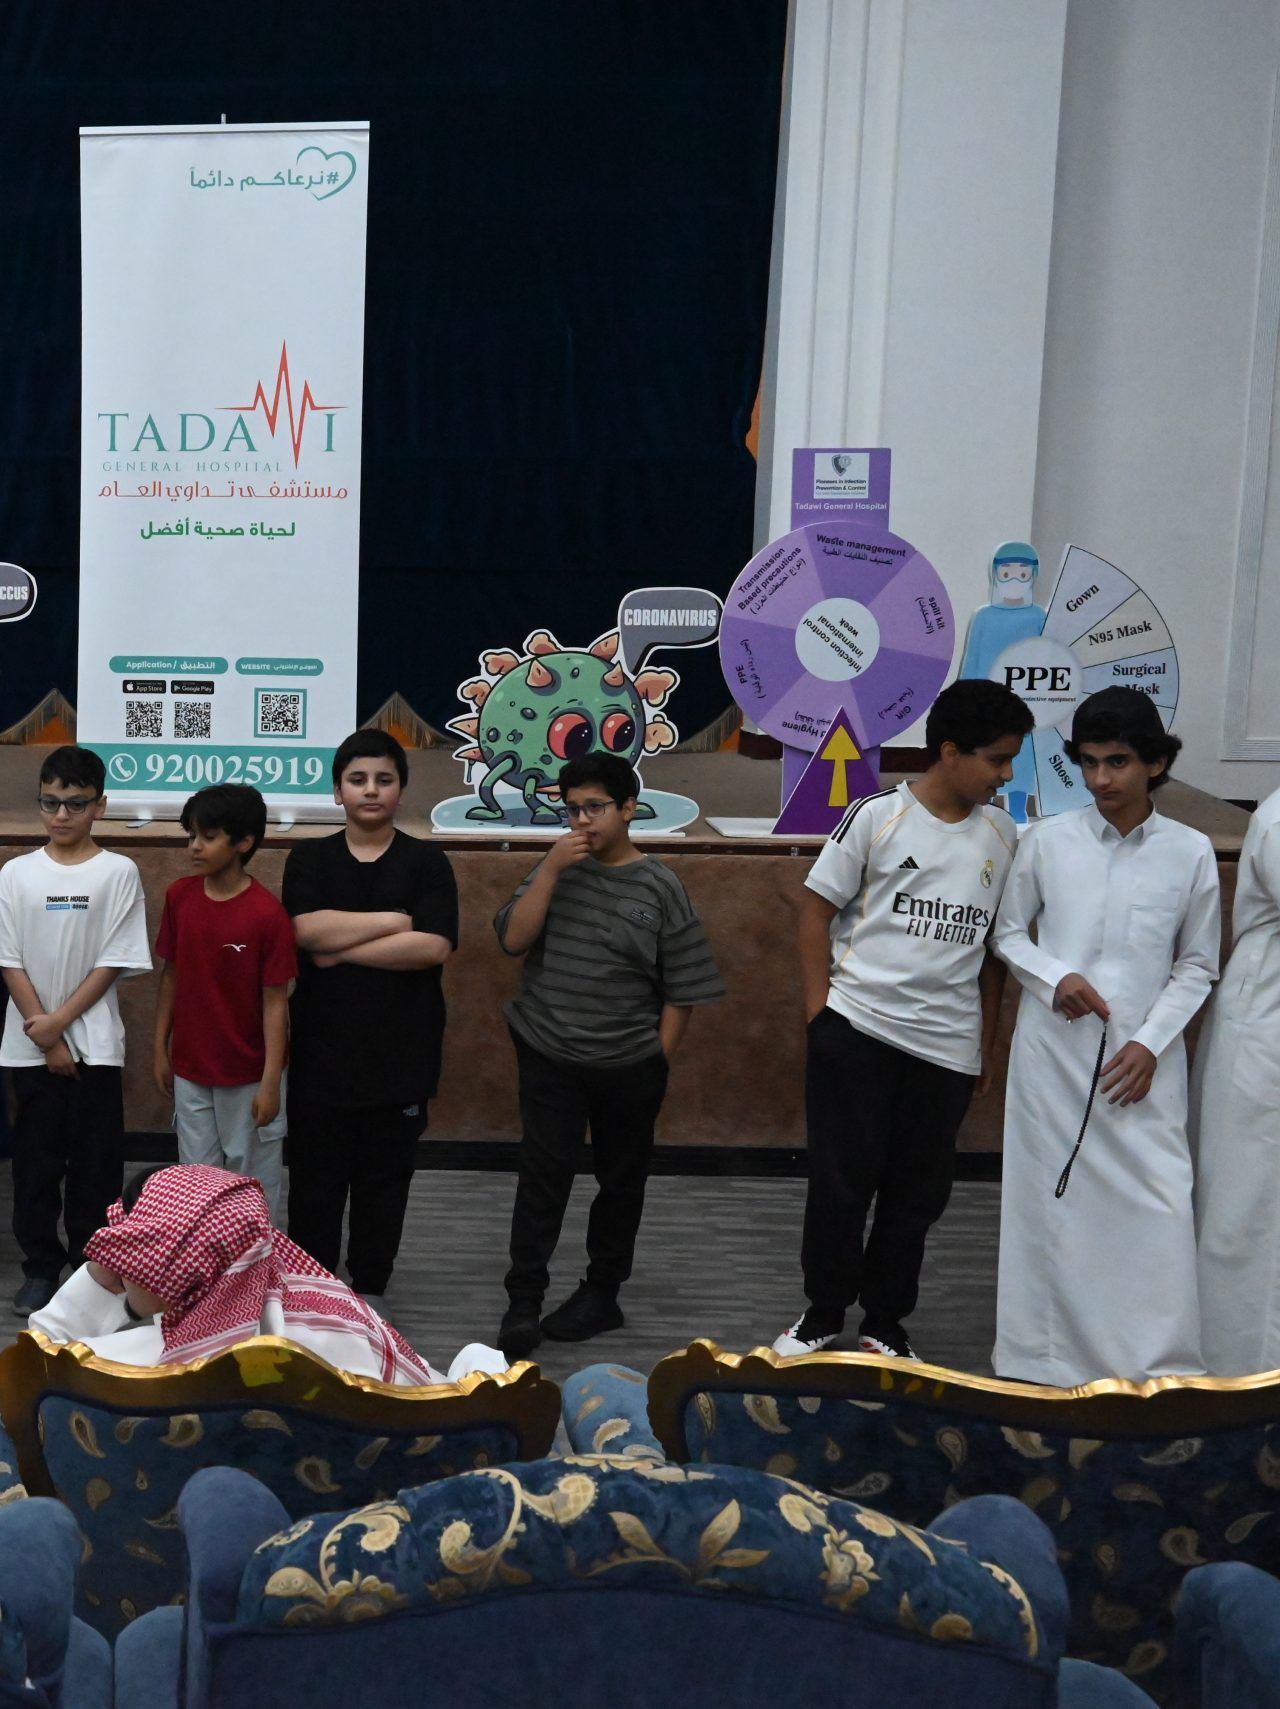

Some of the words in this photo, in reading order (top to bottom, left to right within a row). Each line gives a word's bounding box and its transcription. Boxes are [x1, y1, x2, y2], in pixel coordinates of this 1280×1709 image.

[103, 462, 182, 472] GENERAL
[197, 462, 283, 472] HOSPITAL
[824, 502, 853, 510] General
[855, 502, 887, 511] Hospital
[140, 517, 190, 540] أفضل
[194, 521, 245, 540] صحية
[249, 521, 296, 541] لحياة
[816, 534, 844, 546] Waste
[846, 541, 906, 557] management
[737, 548, 785, 593] Transmission
[737, 586, 762, 610] Based
[760, 547, 801, 589] precautions
[1066, 584, 1100, 612] Gown
[624, 609, 716, 626] CORONAVIRUS
[839, 617, 858, 637] week
[802, 618, 830, 642] control
[813, 615, 863, 658] international
[1088, 631, 1114, 646] N95
[1116, 621, 1152, 639] Mask
[126, 661, 172, 669] Application
[830, 641, 862, 672] Infection
[735, 664, 747, 684] PPE
[1004, 667, 1071, 691] PPE
[1112, 663, 1166, 678] Surgical
[181, 685, 200, 693] Google
[782, 721, 818, 736] Hygiene
[145, 754, 323, 786] 920025919
[1048, 754, 1074, 789] Shose
[892, 892, 989, 928] Emirates
[906, 918, 931, 938] FLY
[933, 922, 977, 946] BETTER
